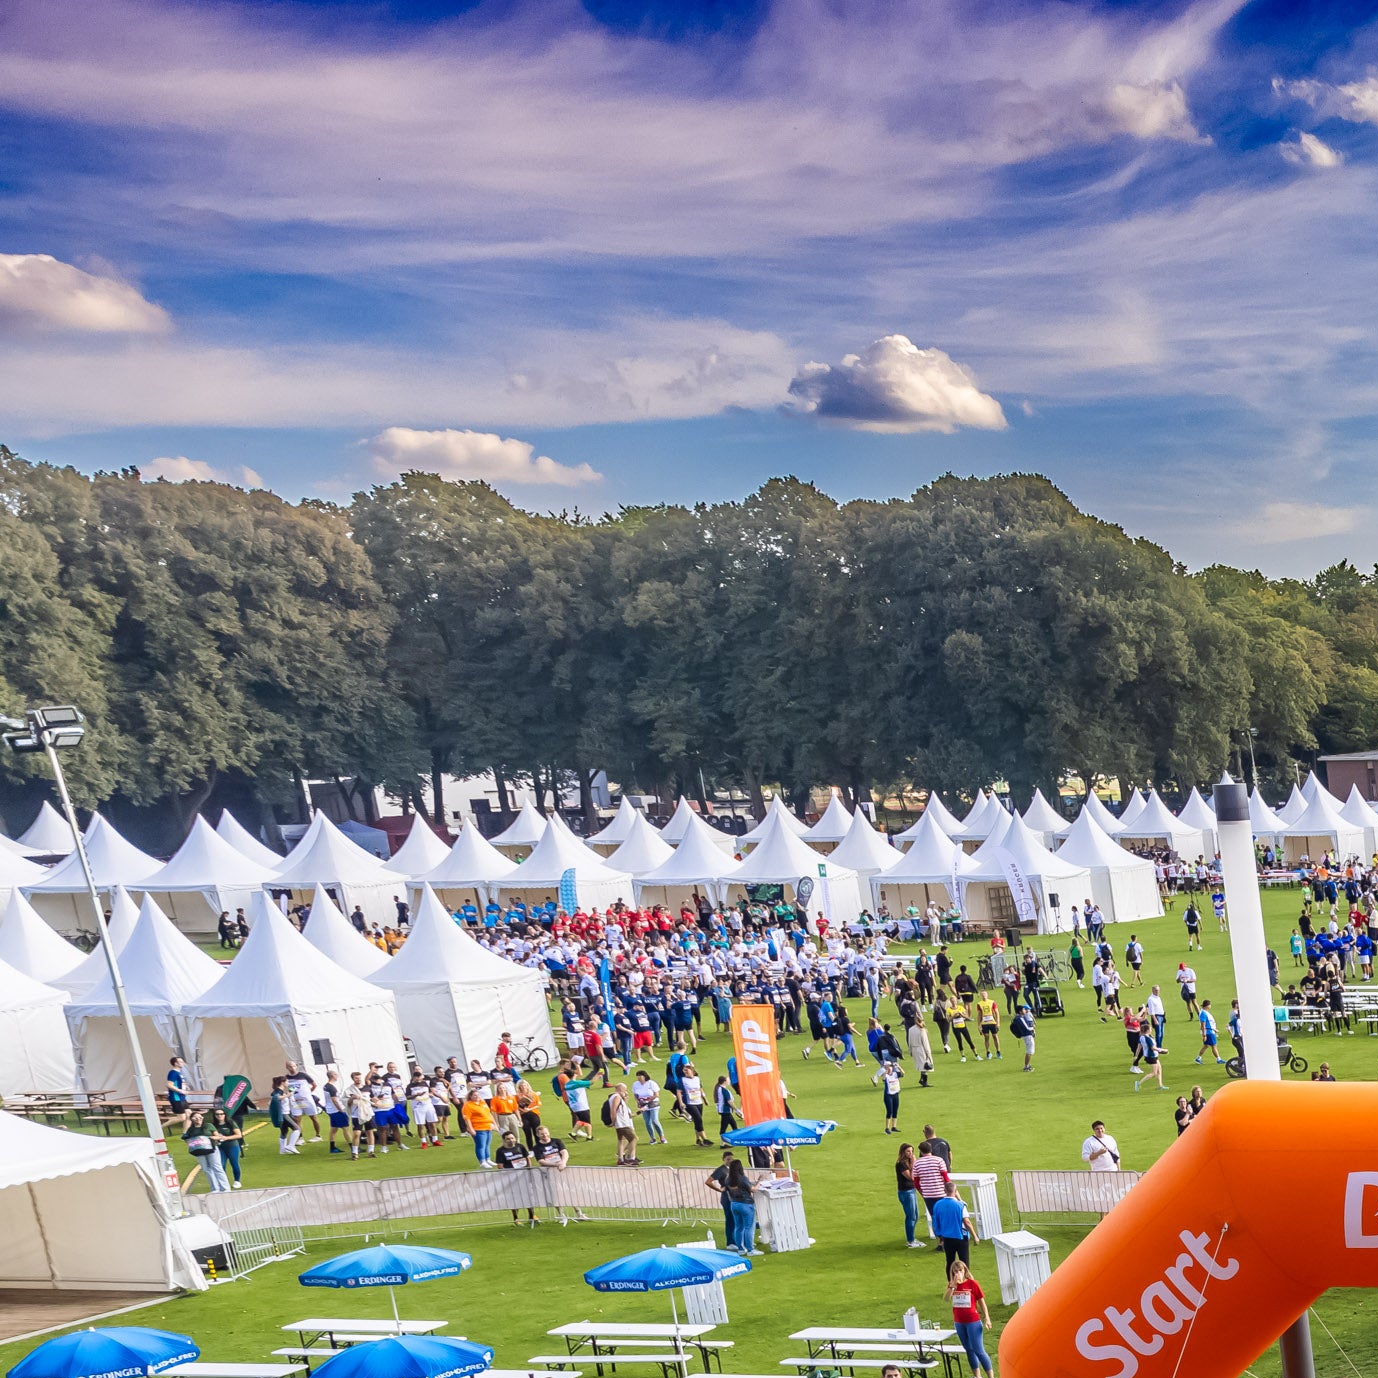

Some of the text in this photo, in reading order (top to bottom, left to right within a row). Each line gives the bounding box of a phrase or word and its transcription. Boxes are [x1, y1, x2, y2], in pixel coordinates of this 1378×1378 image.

[741, 1020, 773, 1076] VIP
[358, 1275, 402, 1285] ERDINGER
[609, 1281, 646, 1290] ERDINGER
[654, 1276, 710, 1288] ALKOHOLFREI
